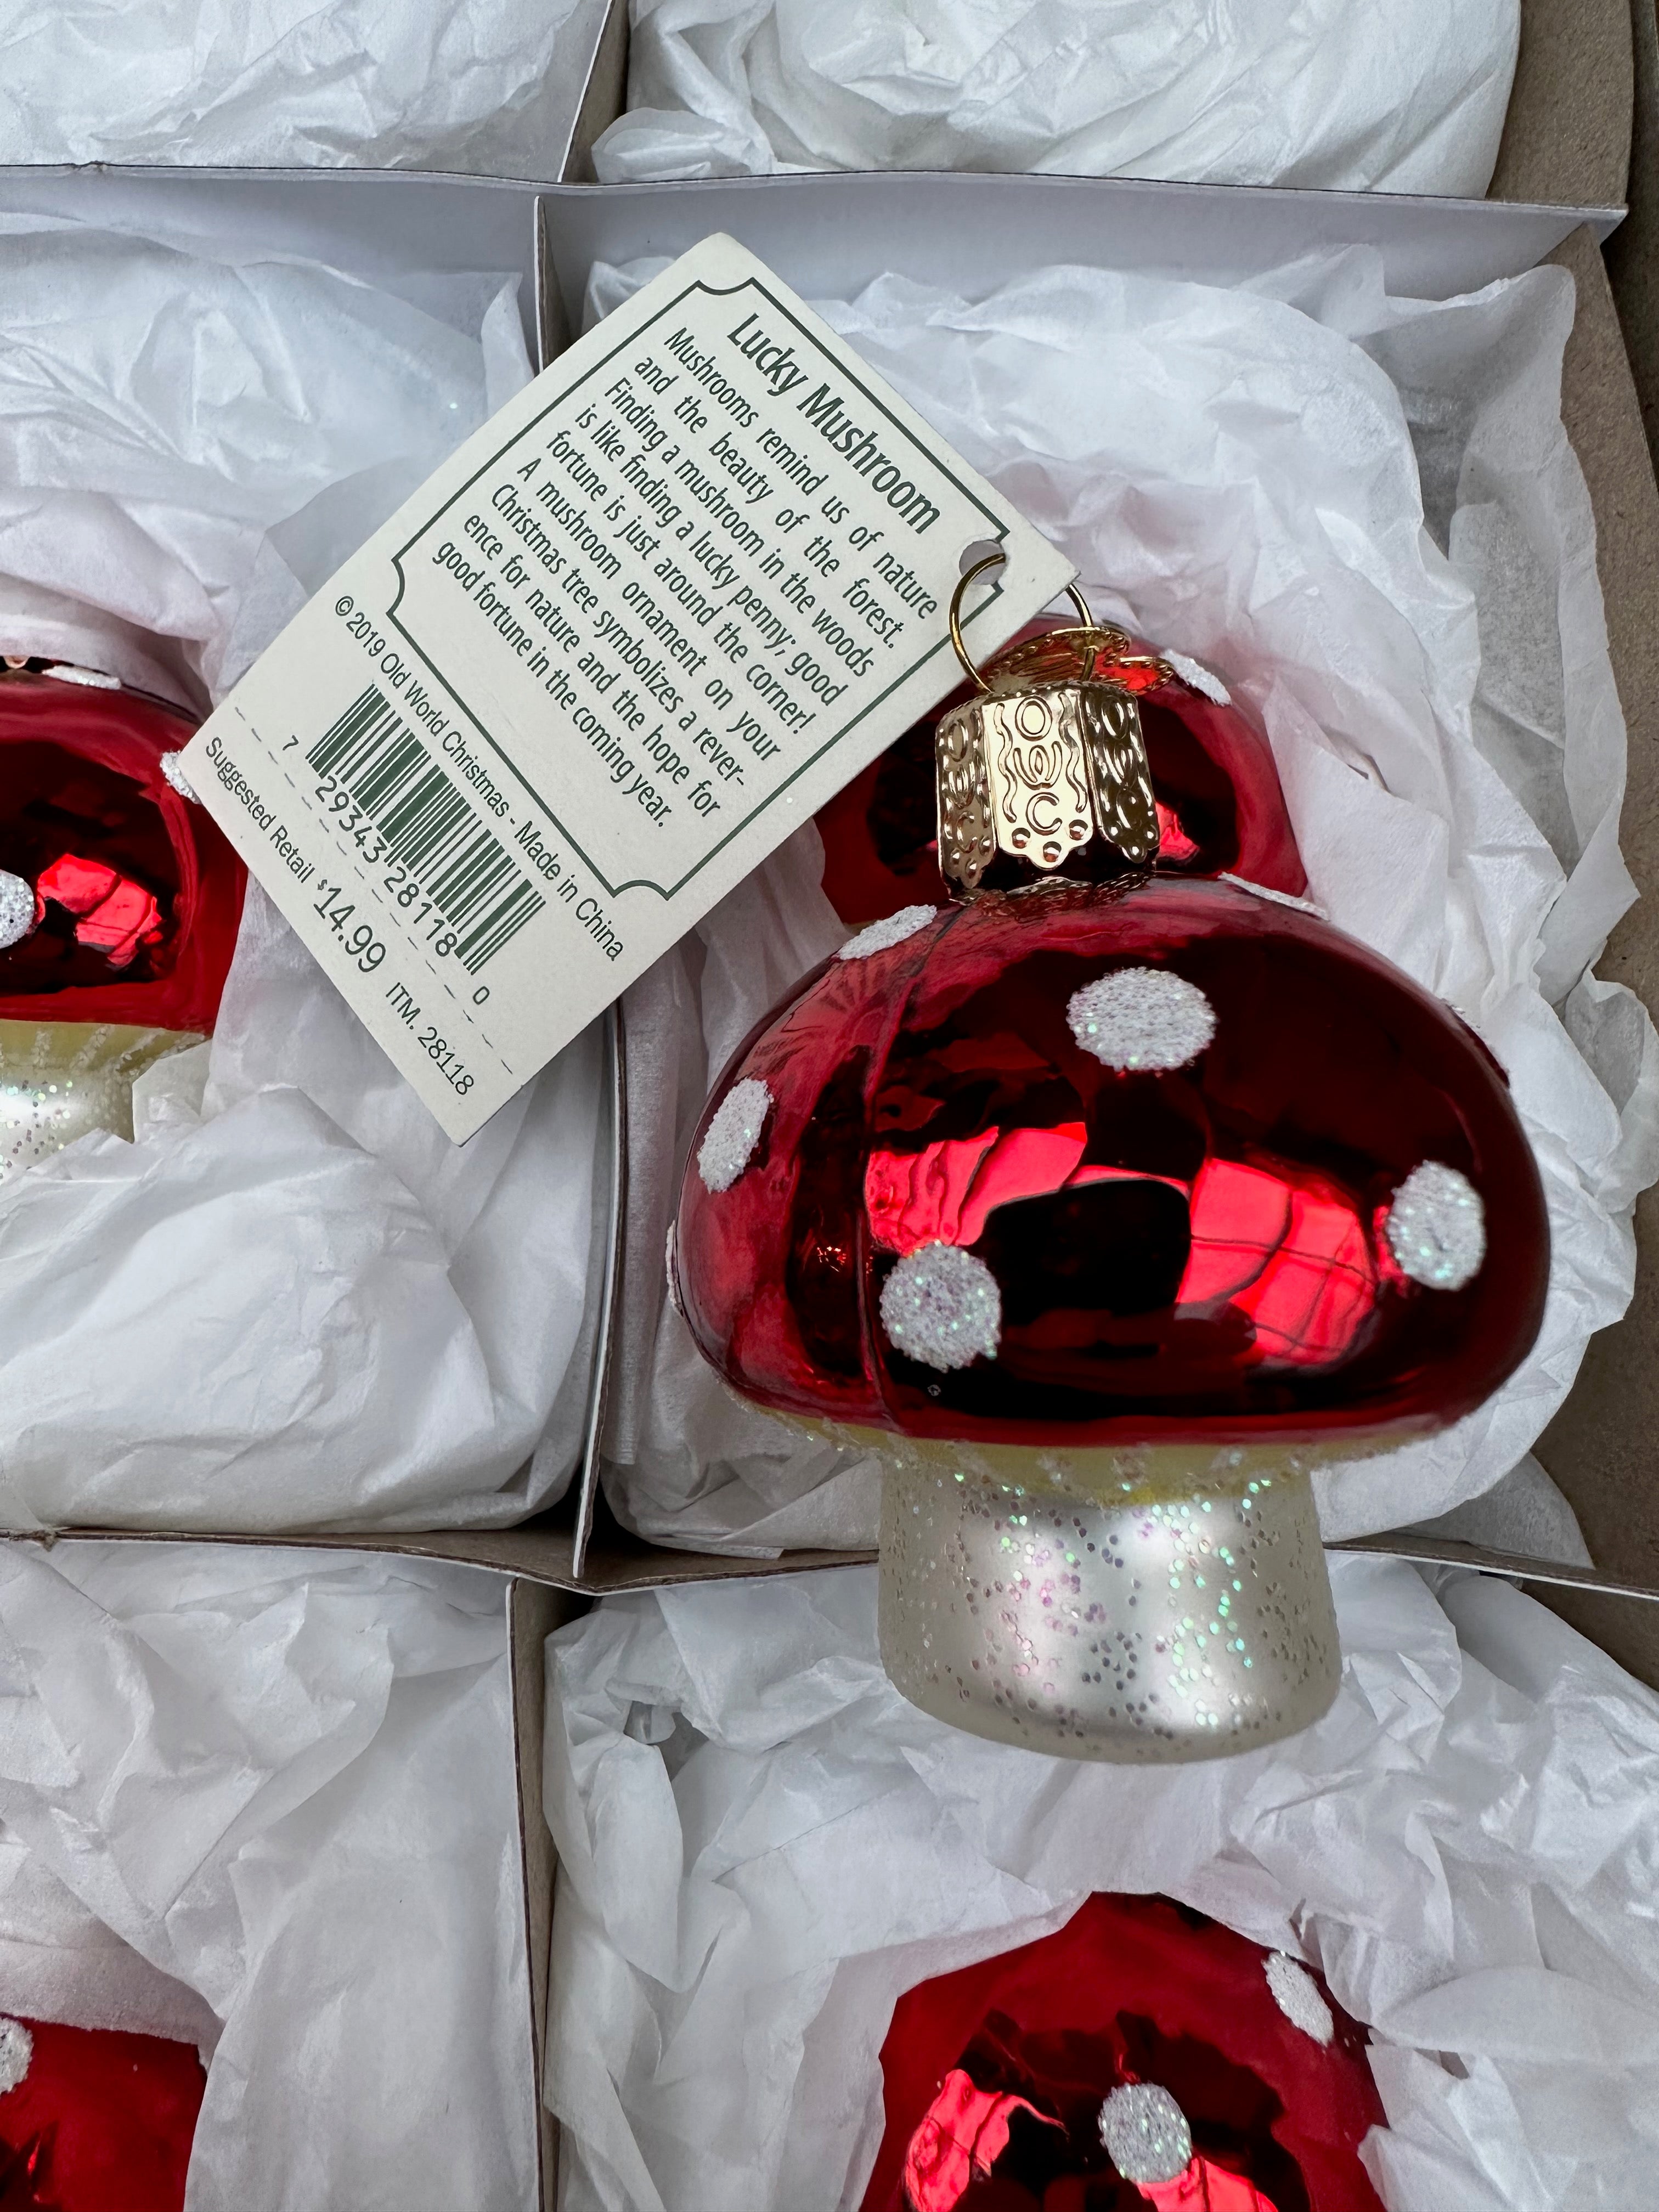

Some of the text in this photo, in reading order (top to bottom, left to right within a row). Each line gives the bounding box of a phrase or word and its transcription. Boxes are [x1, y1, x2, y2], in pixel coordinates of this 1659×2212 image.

[574, 403, 849, 707] is like finding a lucky penny; good
[603, 376, 874, 678] Finding a mushroom in the woods
[634, 356, 905, 650] and the beauty of the forest.
[663, 326, 938, 620] Mushrooms remind us of nature
[726, 312, 941, 535] Lucky Mushroom
[431, 541, 673, 828] good fortune in the coming year.
[463, 514, 721, 818] ence for nature and the hope for
[491, 483, 745, 786] Christmas tree symbolizes a rever-
[516, 457, 782, 761] A mushroom ornament on your
[545, 429, 817, 735] fortune is just around the corner!
[205, 736, 475, 1096] Suggested Retail $14.99 ITM. 28118
[281, 734, 490, 1006] 7 29343 28118 0
[345, 611, 386, 658] 2019
[380, 652, 413, 690] Old
[403, 679, 450, 738] World
[442, 730, 510, 818] Christmas
[514, 820, 561, 881] Made
[556, 874, 579, 904] in
[575, 897, 624, 962] China
